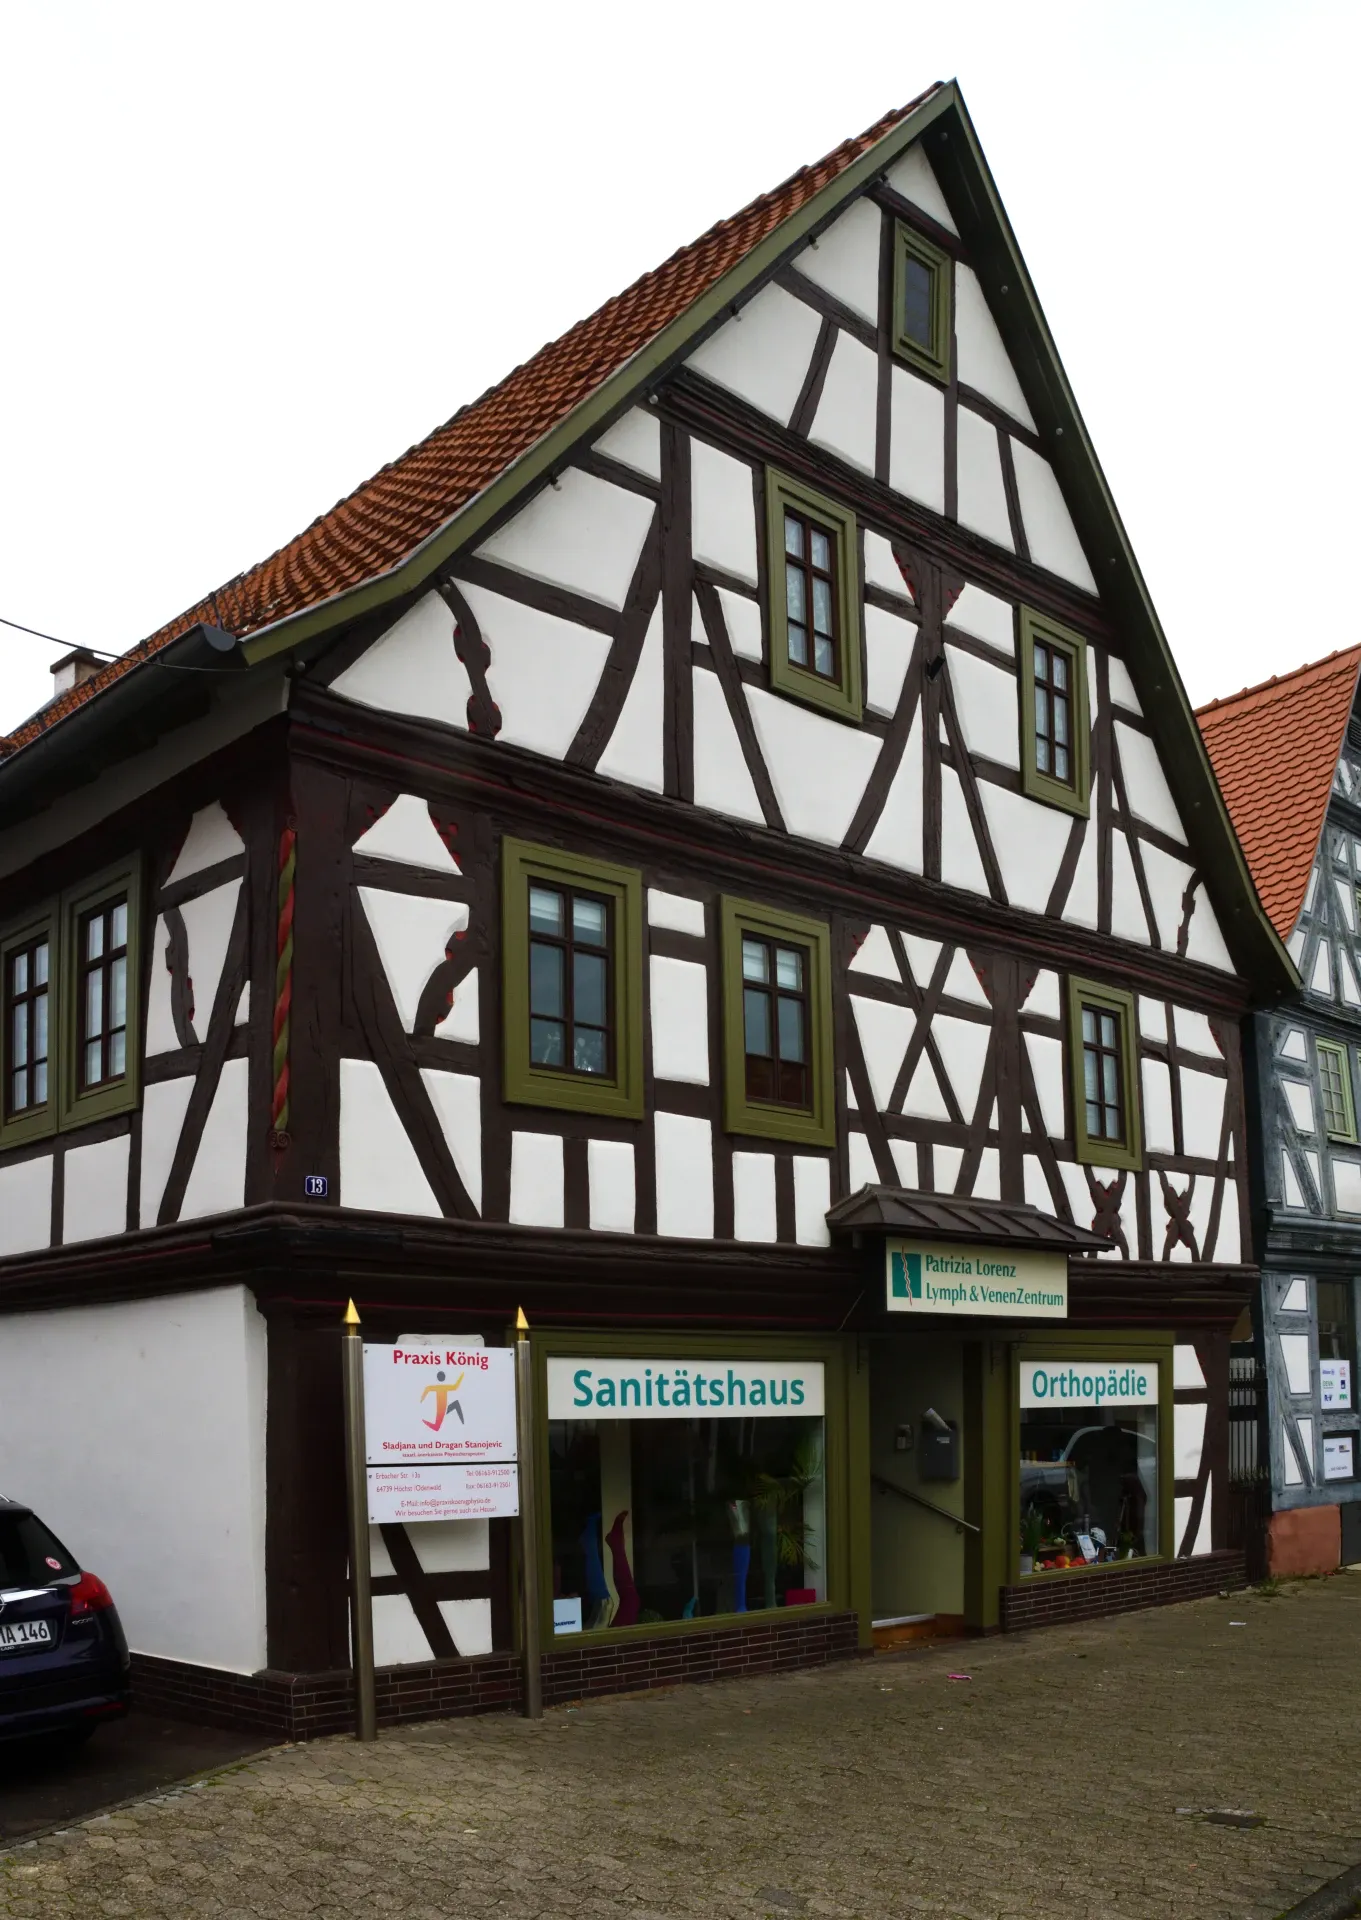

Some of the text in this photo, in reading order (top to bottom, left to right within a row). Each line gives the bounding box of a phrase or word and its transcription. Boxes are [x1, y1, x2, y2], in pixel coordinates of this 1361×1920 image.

[311, 1178, 323, 1194] 13
[925, 1254, 1017, 1278] Patrizia Lorenz
[926, 1282, 1064, 1307] Lymph & VenenZentrum
[393, 1349, 489, 1371] Praxis König
[573, 1368, 805, 1407] Sanitätshaus
[1032, 1369, 1147, 1405] Orthopädie
[382, 1441, 416, 1451] Sladjana
[418, 1441, 433, 1449] und
[435, 1441, 463, 1451] Dragan
[18, 1622, 48, 1641] 146
